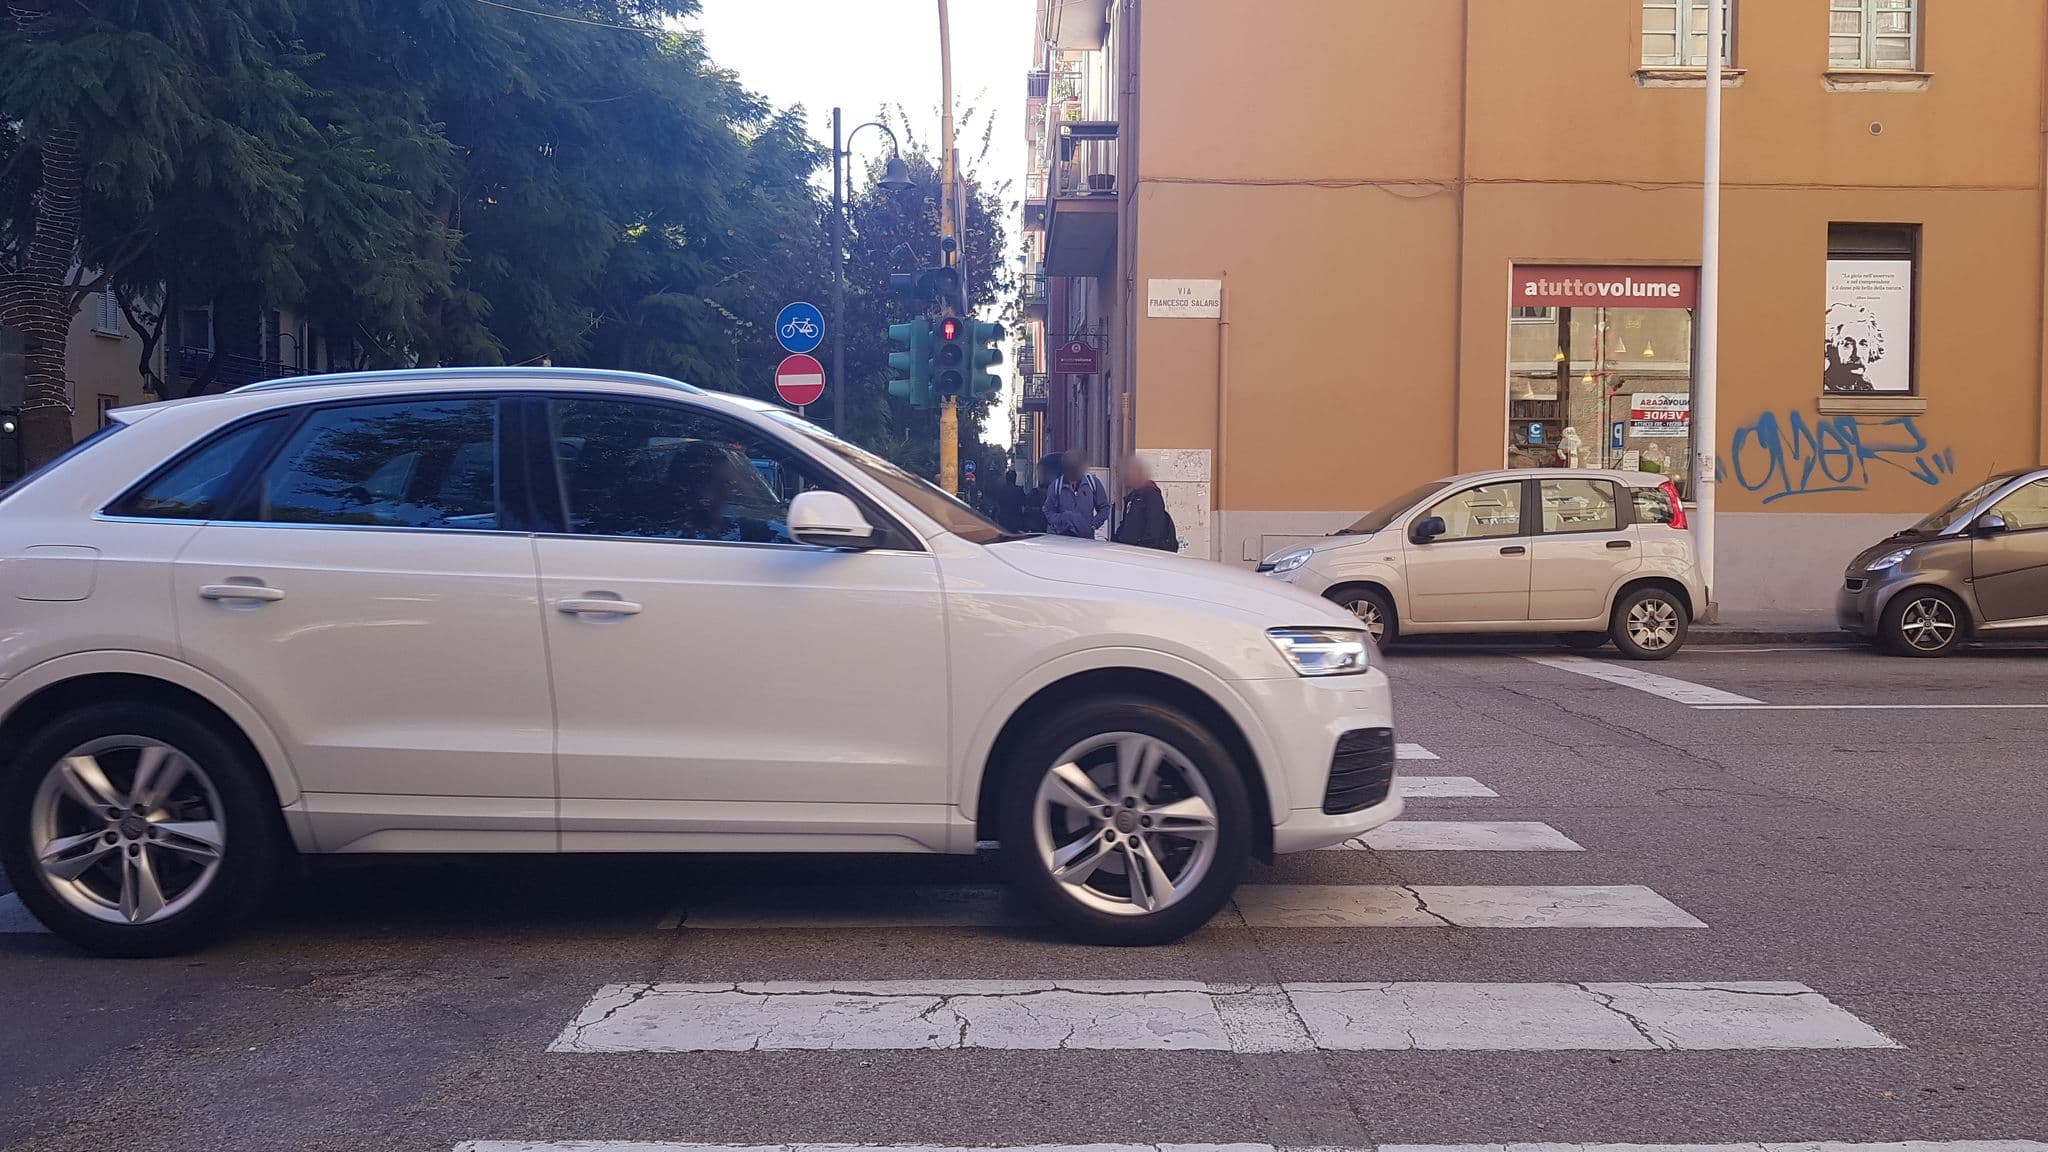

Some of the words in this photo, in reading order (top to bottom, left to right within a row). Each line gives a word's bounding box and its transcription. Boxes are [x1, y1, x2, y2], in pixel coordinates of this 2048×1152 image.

[1177, 287, 1192, 295] VIA
[1524, 277, 1681, 297] atuttovolume
[1149, 299, 1189, 307] FRANCESCO
[1191, 299, 1219, 307] SALARIS
